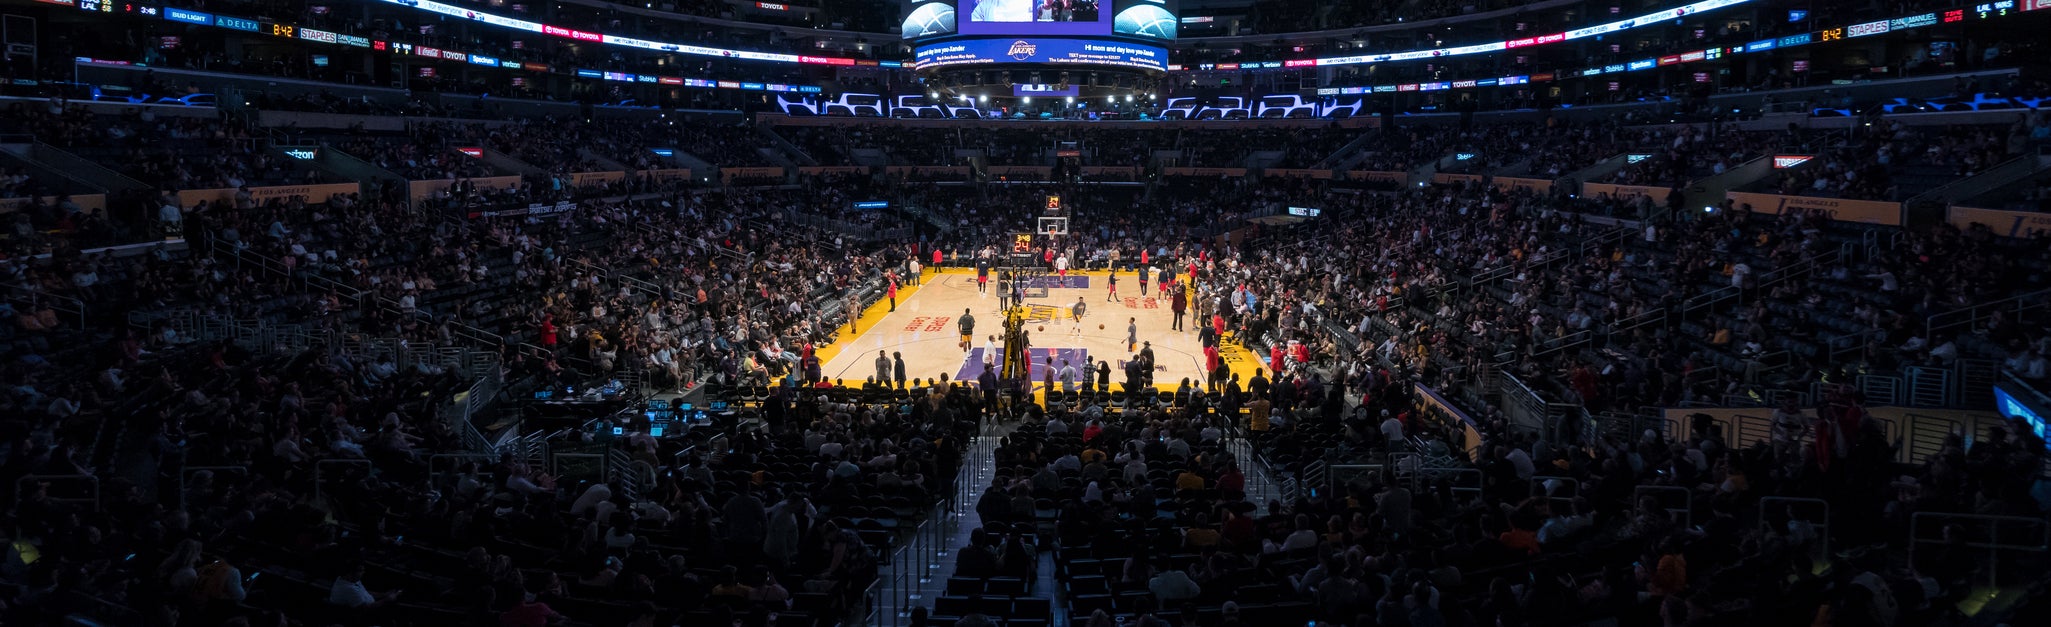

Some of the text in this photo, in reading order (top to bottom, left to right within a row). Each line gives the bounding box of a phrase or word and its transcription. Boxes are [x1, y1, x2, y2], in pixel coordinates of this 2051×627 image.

[187, 14, 206, 22] LIGHT
[1908, 13, 1936, 22] MANUEL
[227, 20, 258, 30] DELTA
[1849, 21, 1888, 36] STAPLES
[273, 24, 293, 37] 8:42
[580, 31, 599, 40] TOYOTA
[1822, 28, 1842, 41] 8:42
[301, 30, 335, 42] STAPLES
[1785, 35, 1810, 45] DELTA
[1008, 44, 1036, 56] LAKERS
[443, 51, 467, 61] TOYOTA
[473, 55, 494, 65] Spectrum
[1681, 52, 1705, 62] TOSHIBA
[1015, 241, 1029, 252] 24
